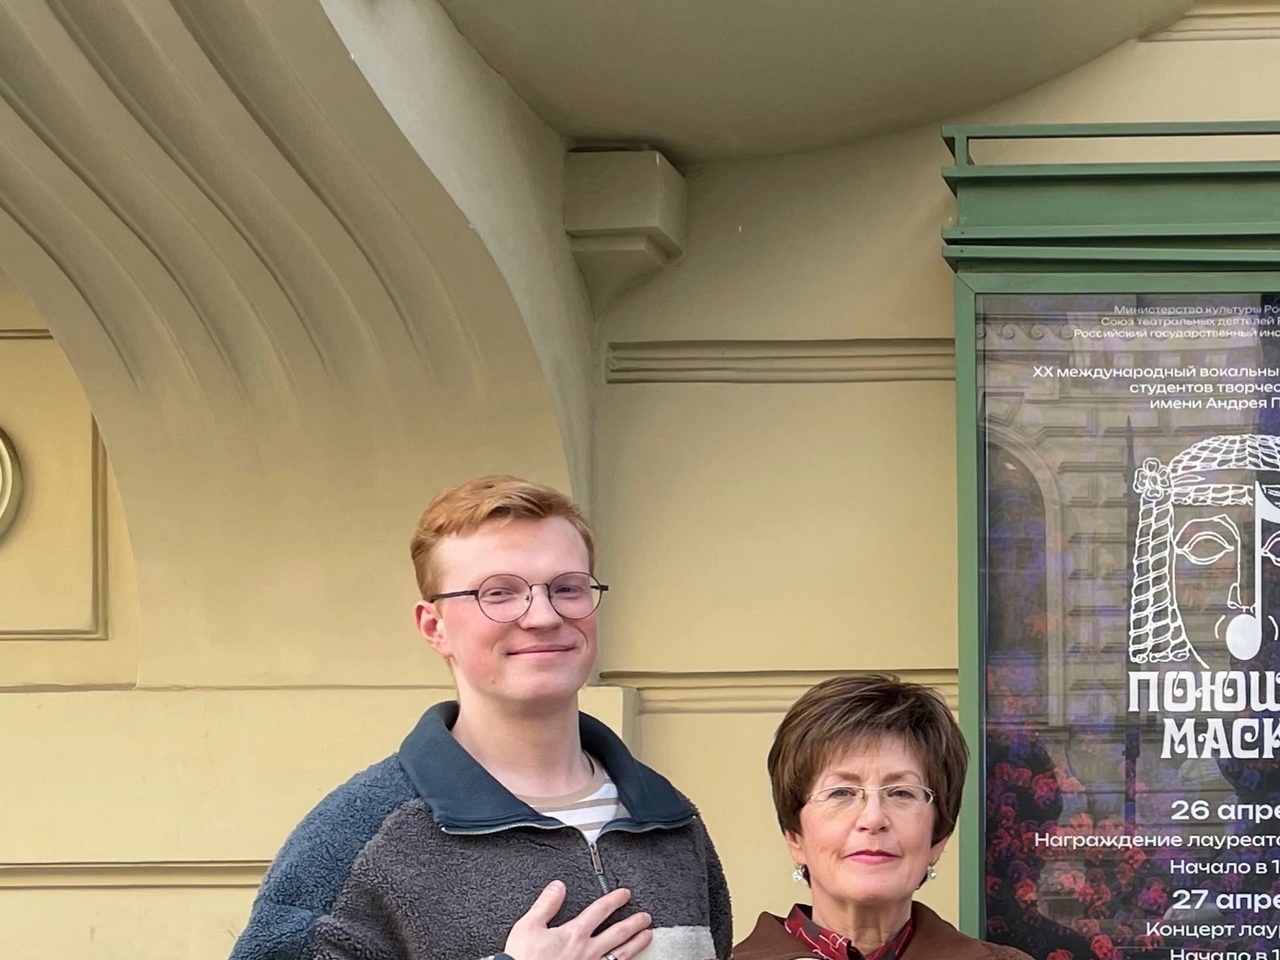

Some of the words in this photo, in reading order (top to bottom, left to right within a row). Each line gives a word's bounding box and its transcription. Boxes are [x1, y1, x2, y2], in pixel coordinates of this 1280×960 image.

[1114, 305, 1202, 315] Министерство
[1205, 305, 1261, 316] культуры
[1101, 316, 1133, 327] Союз
[1137, 317, 1215, 328] театральных
[1218, 316, 1274, 328] деятелей
[1074, 328, 1146, 339] Российский
[1149, 328, 1257, 340] государственный
[1057, 365, 1196, 380] международный
[1130, 382, 1213, 395] студентов
[1150, 399, 1201, 409] имени
[1206, 398, 1267, 412] Андрея
[1171, 800, 1210, 820] 26
[1034, 832, 1182, 850] Награждение
[1170, 859, 1251, 875] Начало
[1256, 862, 1267, 875] в
[1172, 890, 1210, 910] 27
[1146, 922, 1234, 939] Концерт
